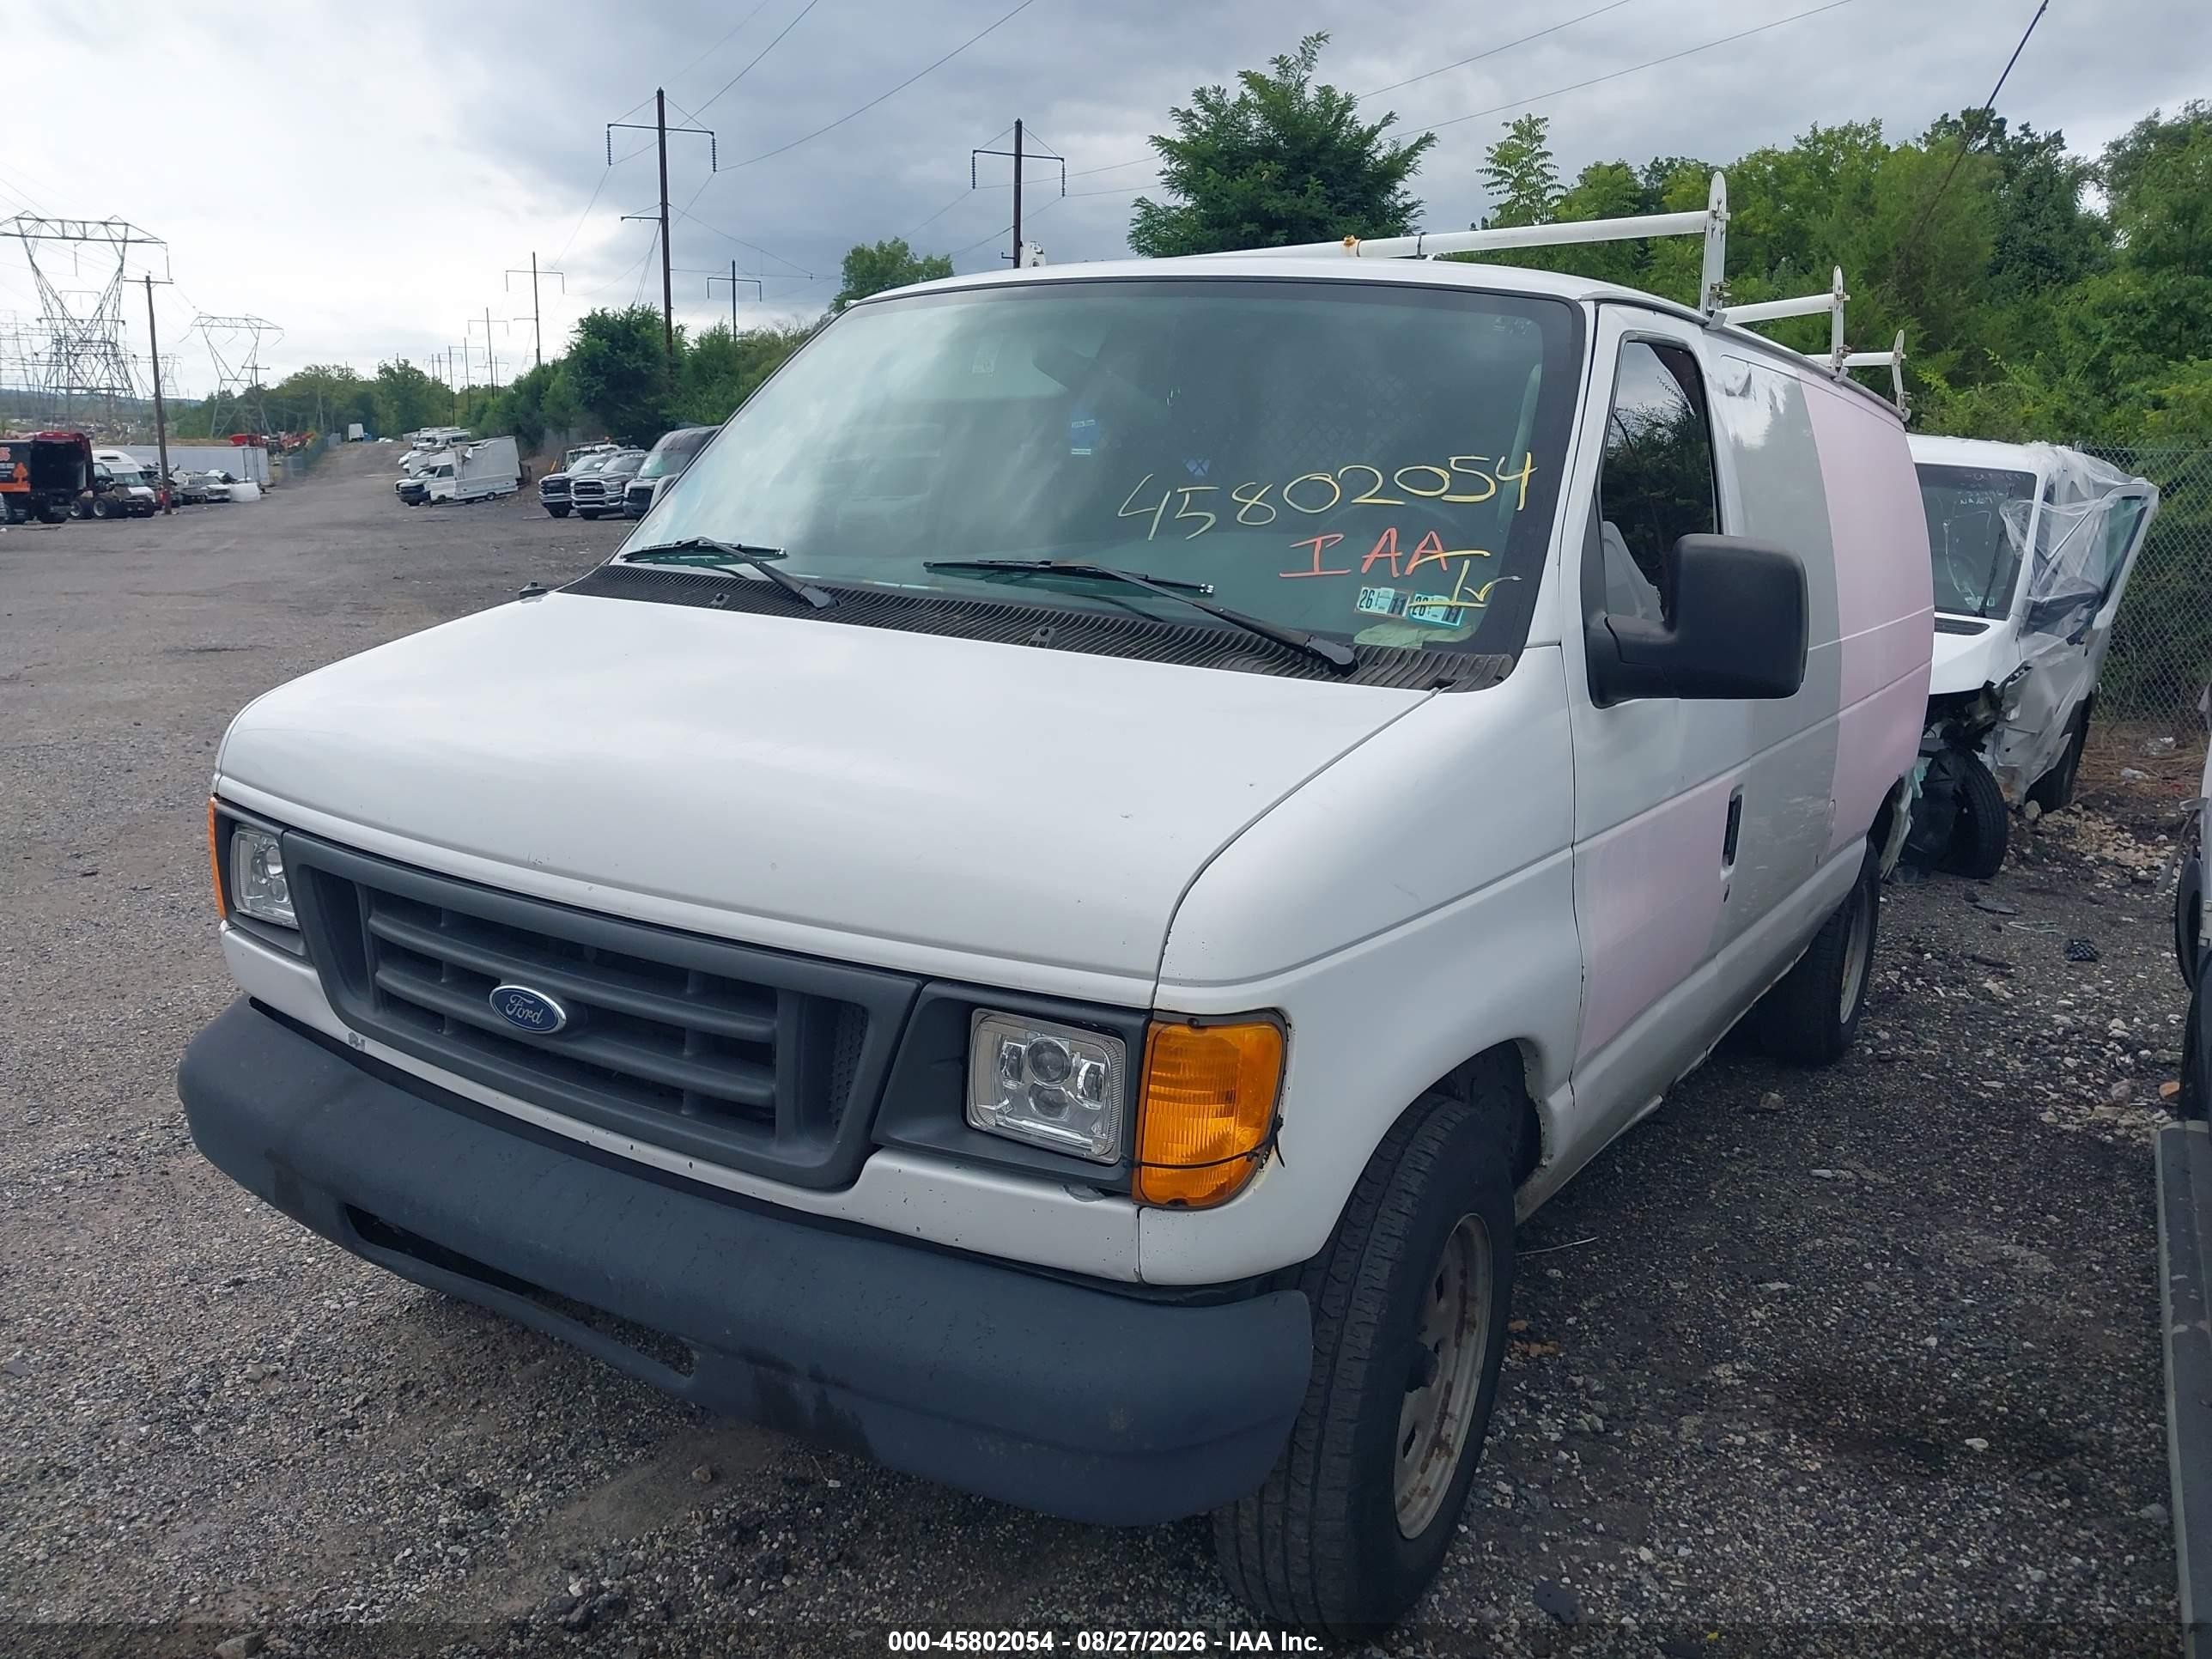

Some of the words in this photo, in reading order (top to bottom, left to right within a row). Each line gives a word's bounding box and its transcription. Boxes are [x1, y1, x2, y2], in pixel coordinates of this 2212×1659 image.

[1117, 452, 1538, 541] 45802054
[1279, 527, 1448, 577] IAA
[1358, 589, 1376, 609] 26
[505, 994, 544, 1024] Ford
